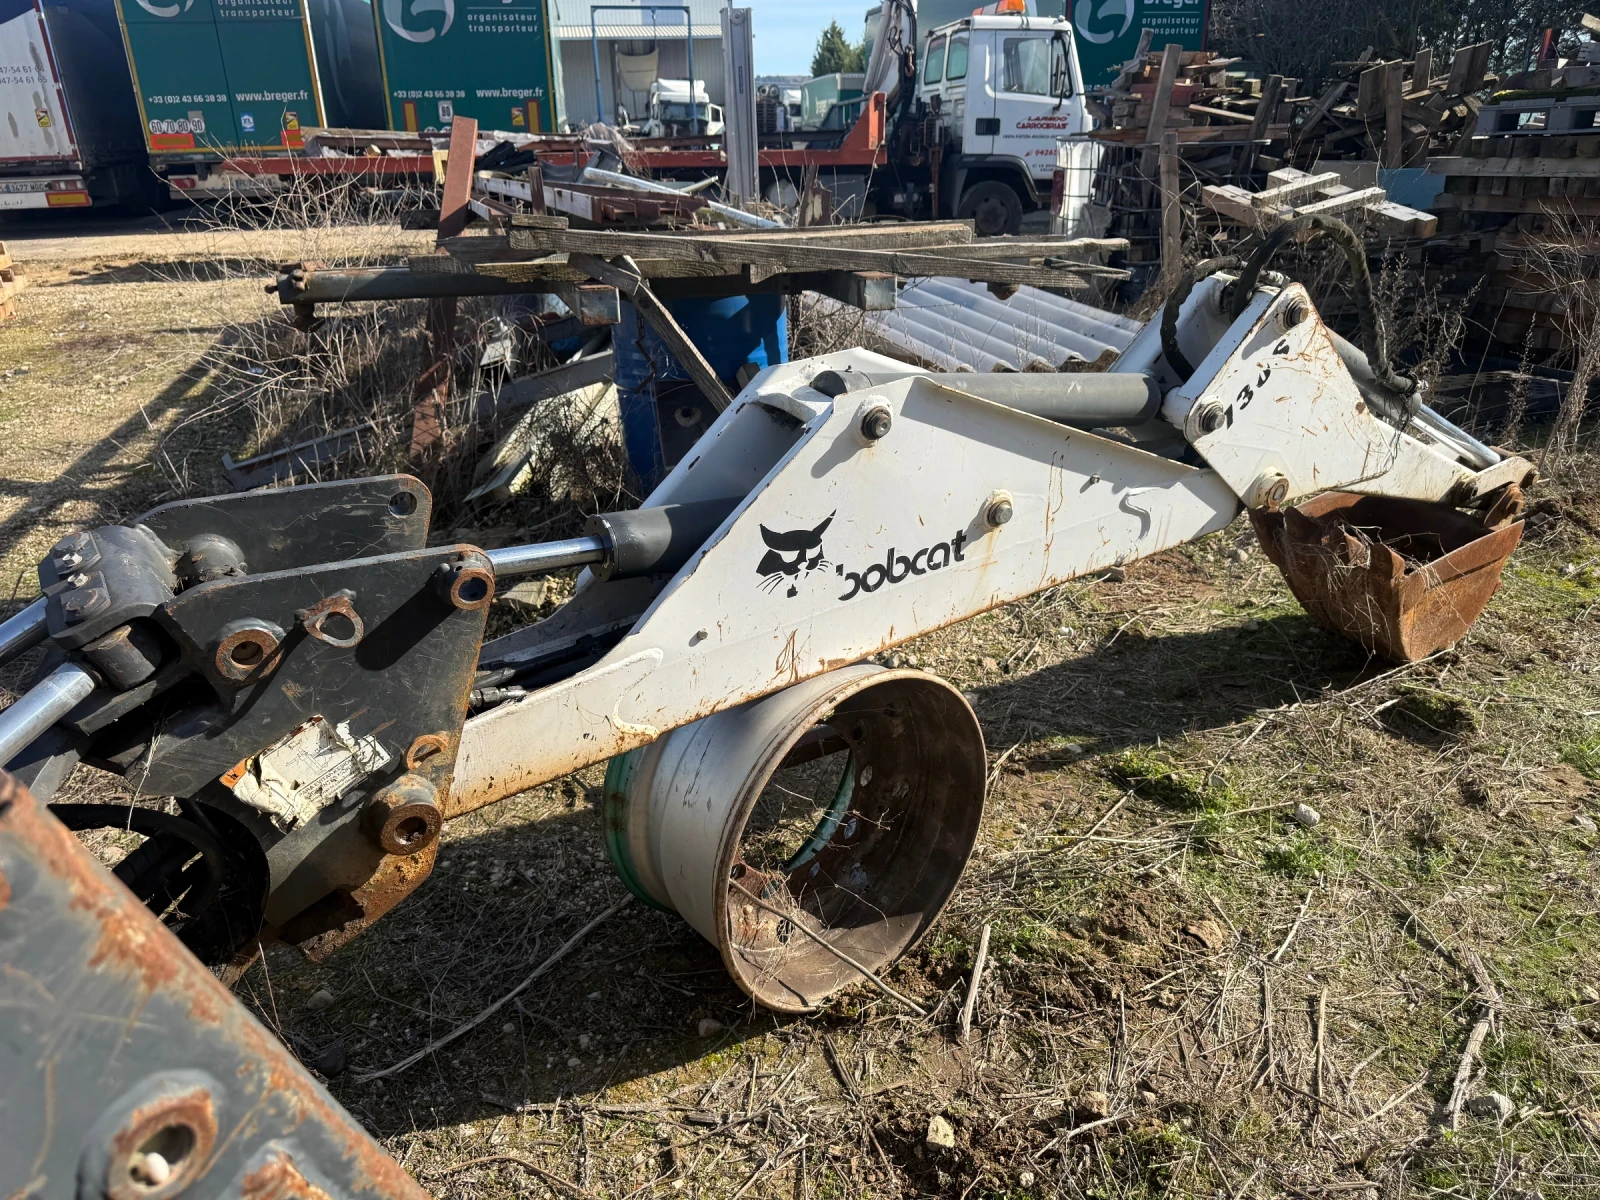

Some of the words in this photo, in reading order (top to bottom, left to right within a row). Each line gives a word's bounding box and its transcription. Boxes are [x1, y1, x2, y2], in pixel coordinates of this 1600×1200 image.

[219, 8, 295, 18] transporteur
[467, 13, 537, 22] organisateur
[1141, 16, 1200, 26] organisateur
[468, 24, 538, 33] transporteur
[1153, 27, 1199, 35] nsporteur
[235, 90, 308, 102] www.breger.fr
[475, 87, 544, 99] www.breger.fr
[151, 120, 162, 132] 60
[164, 120, 176, 132] 70
[177, 119, 189, 132] 80
[191, 119, 203, 131] 90
